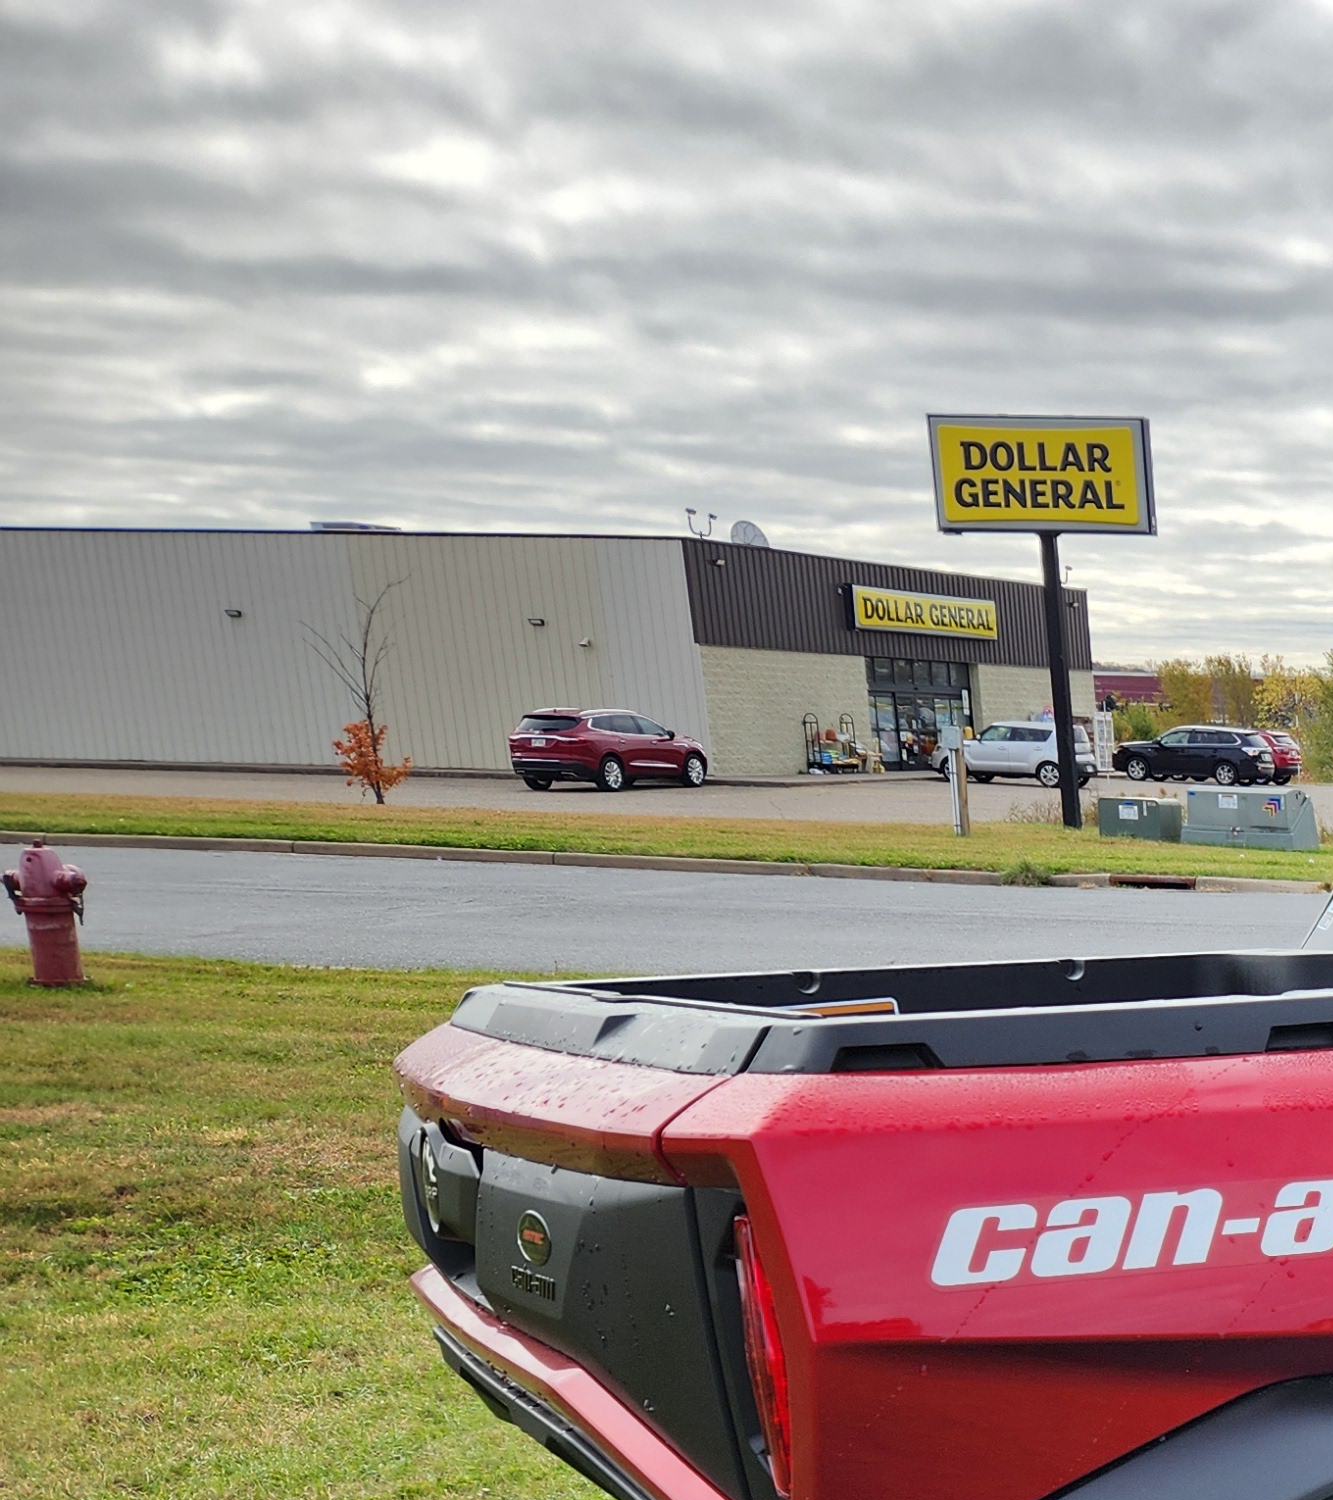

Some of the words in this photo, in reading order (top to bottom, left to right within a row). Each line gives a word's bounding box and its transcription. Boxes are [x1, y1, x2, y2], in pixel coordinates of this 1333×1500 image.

[960, 441, 1112, 473] DOLLAR
[954, 477, 1125, 510] GENERAL
[862, 596, 925, 625] DOLLAR
[929, 603, 994, 631] GENERAL
